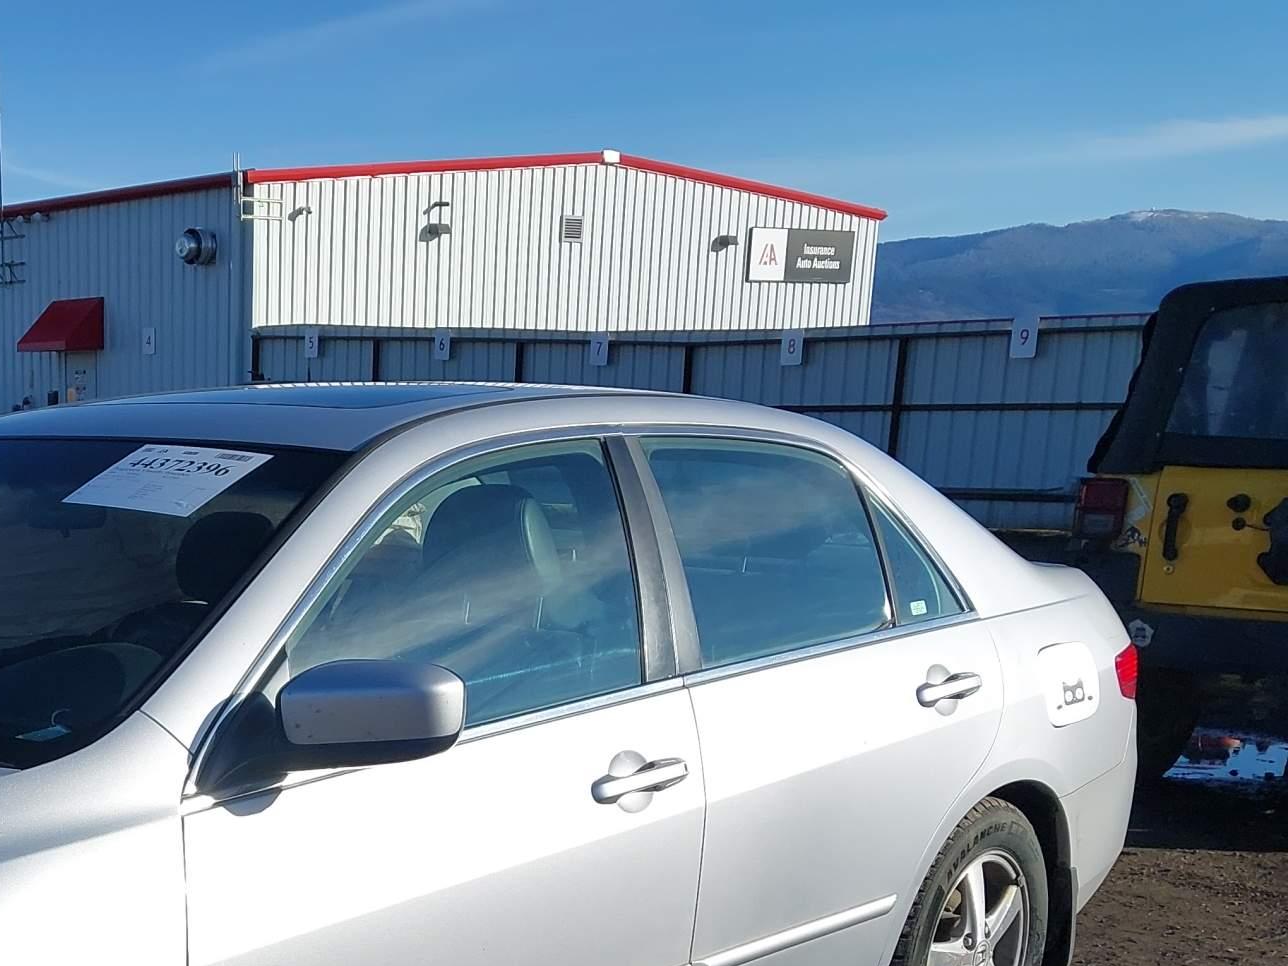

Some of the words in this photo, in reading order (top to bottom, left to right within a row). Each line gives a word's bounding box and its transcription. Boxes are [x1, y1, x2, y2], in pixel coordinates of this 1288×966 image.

[803, 243, 835, 256] Insurance
[795, 257, 812, 269] Auto
[812, 257, 841, 269] Auctions
[308, 336, 315, 349] 5
[1019, 328, 1030, 346] 9
[438, 338, 446, 352] 6
[595, 341, 603, 356] 7
[787, 338, 796, 355] 8
[129, 456, 234, 477] 44372396
